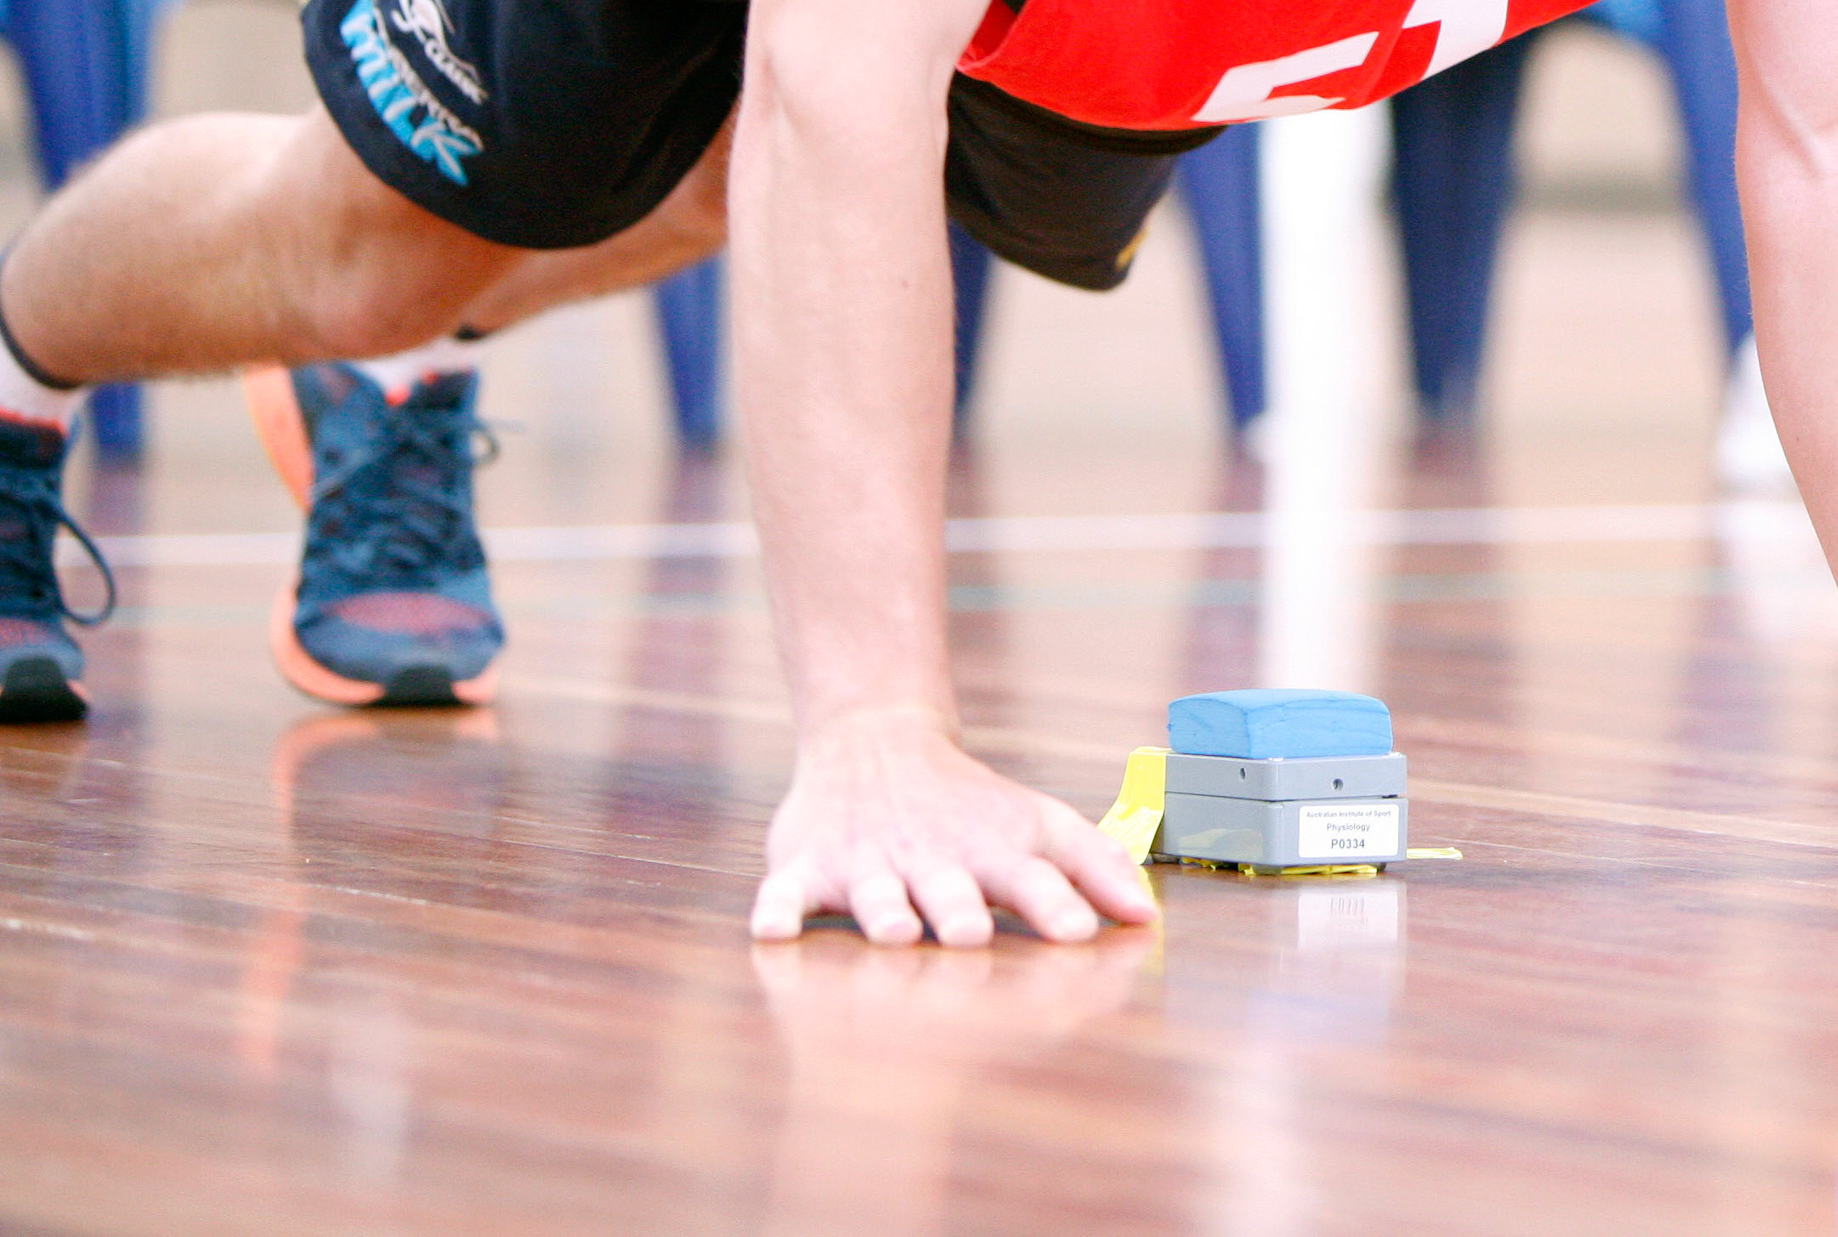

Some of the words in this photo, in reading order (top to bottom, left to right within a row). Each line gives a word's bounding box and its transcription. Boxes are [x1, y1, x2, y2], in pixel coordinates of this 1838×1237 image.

[1374, 810, 1391, 818] Sport
[1326, 822, 1371, 833] Physiology
[1331, 838, 1365, 849] P0334
